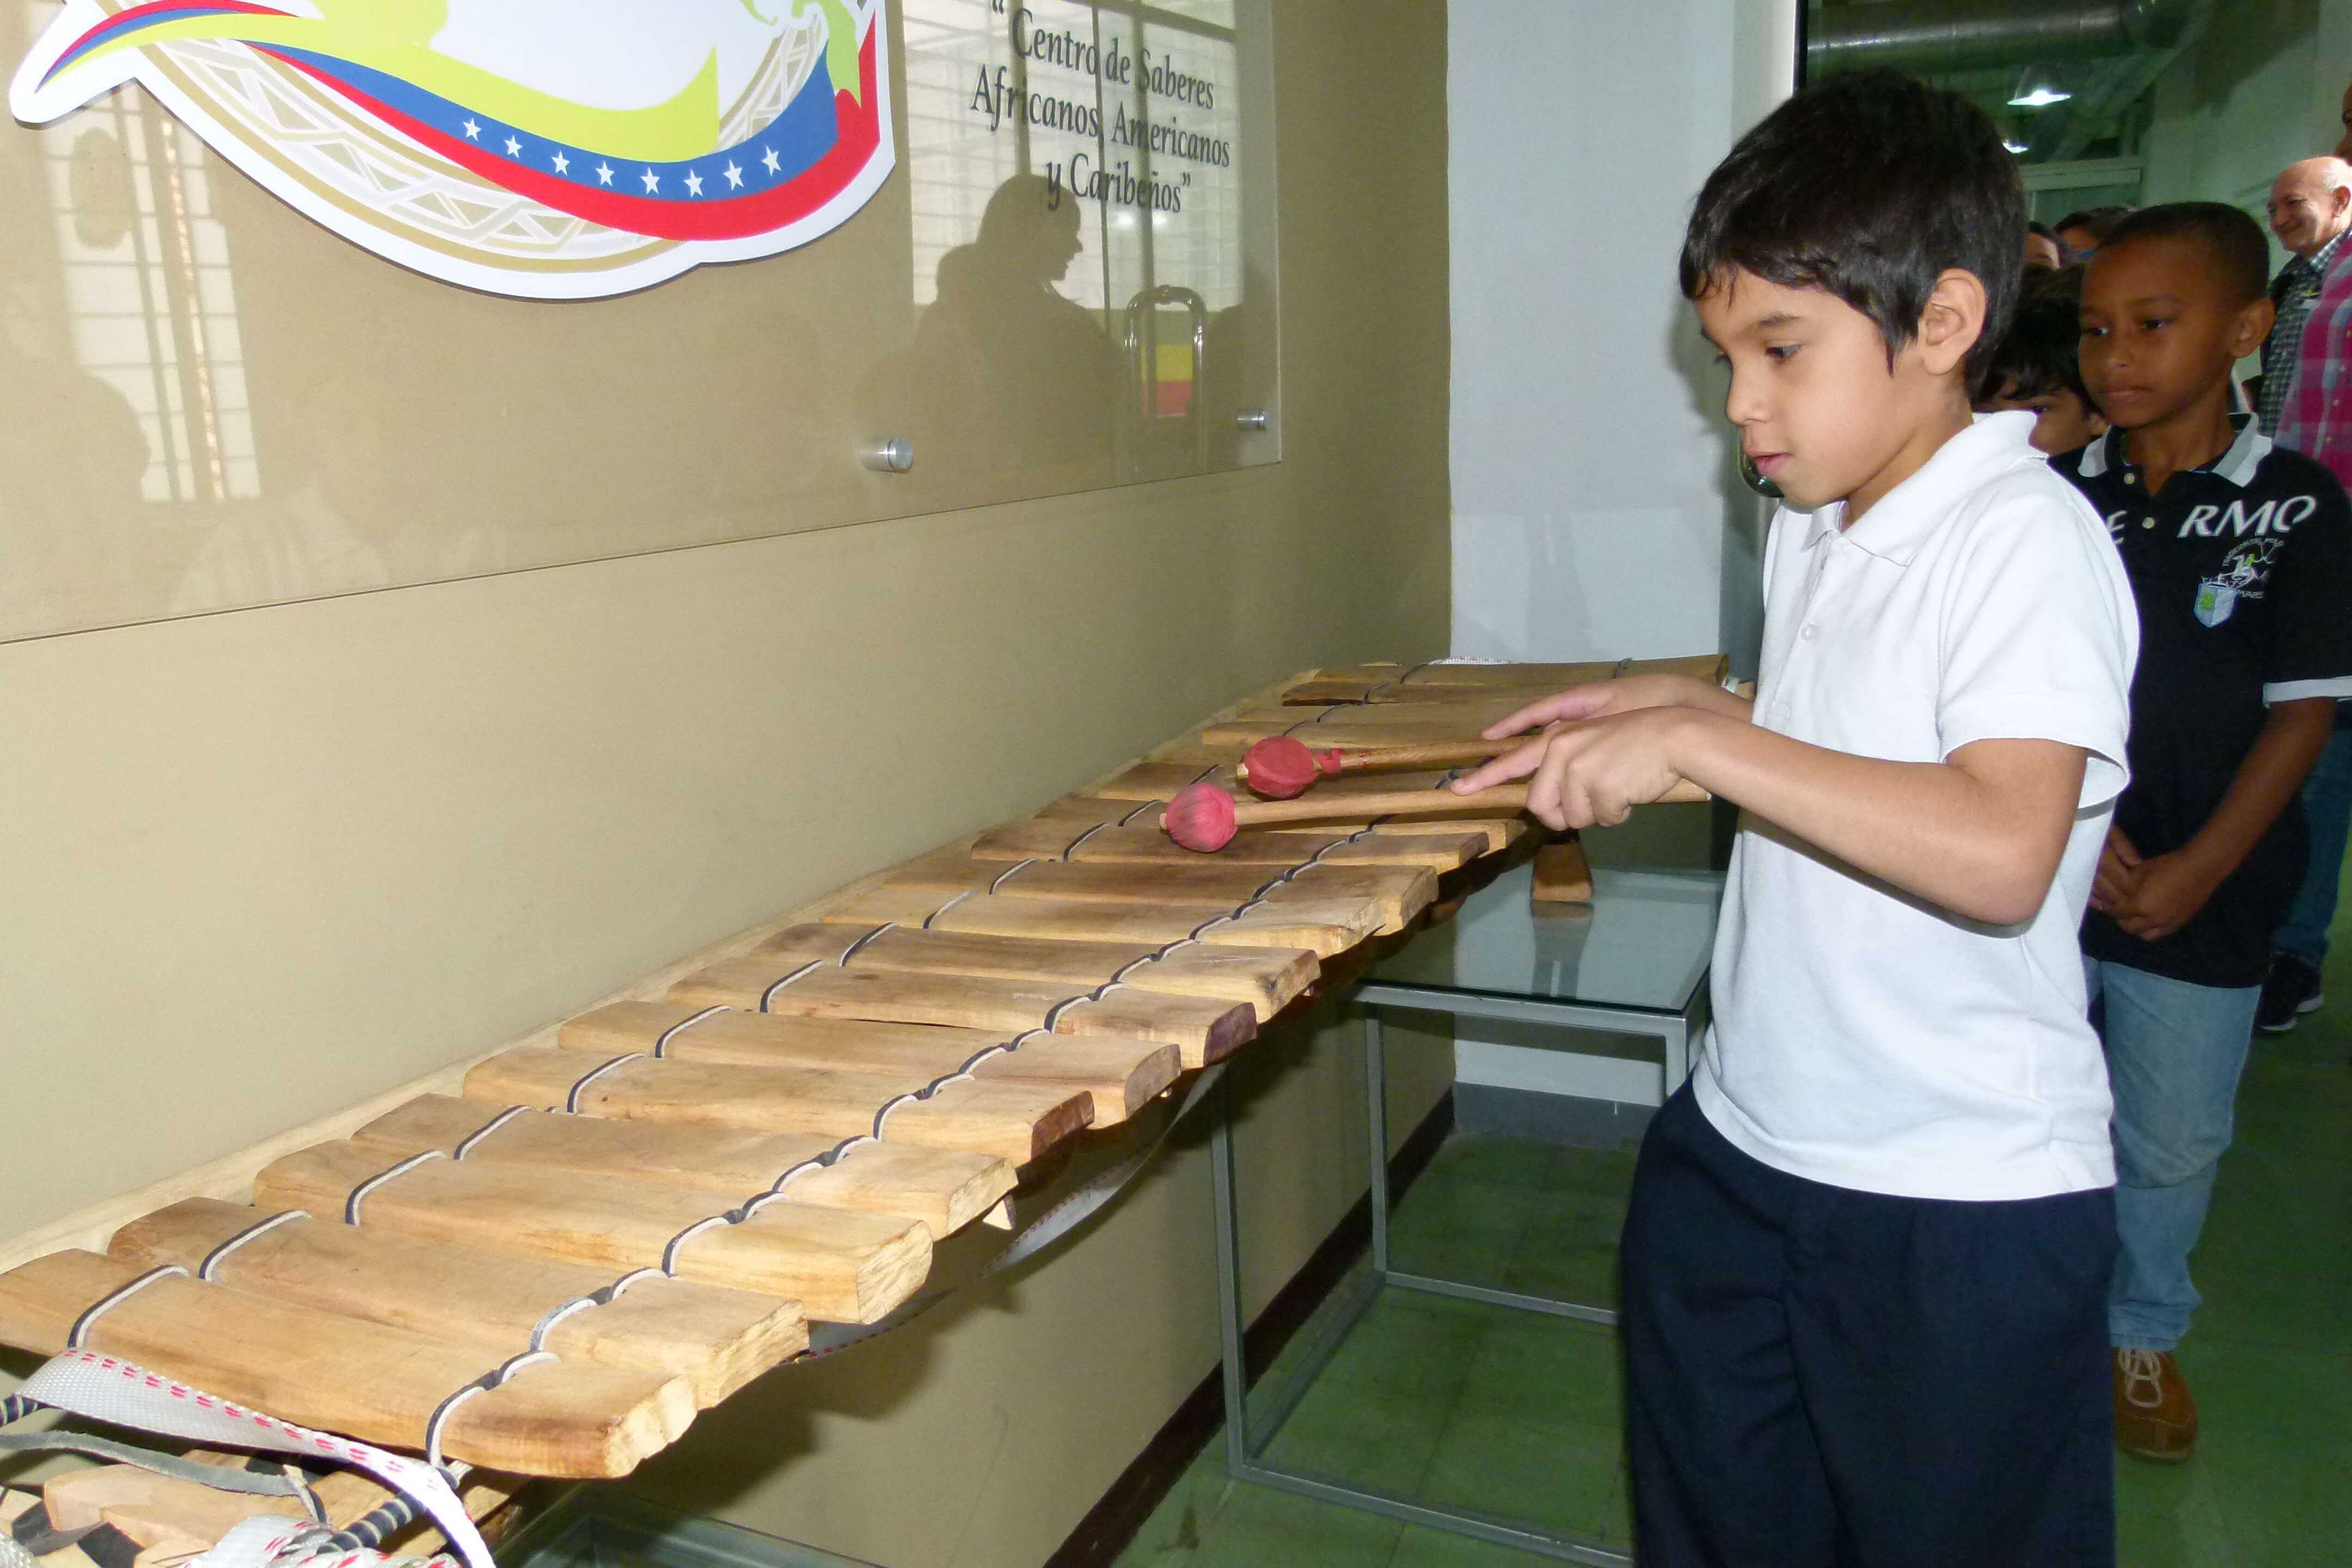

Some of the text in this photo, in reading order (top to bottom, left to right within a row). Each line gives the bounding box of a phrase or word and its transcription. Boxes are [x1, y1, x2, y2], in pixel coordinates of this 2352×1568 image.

[1105, 37, 1131, 84] de
[1137, 48, 1214, 109] Saberes
[1111, 100, 1230, 167] Americanos
[1046, 162, 1061, 211] y
